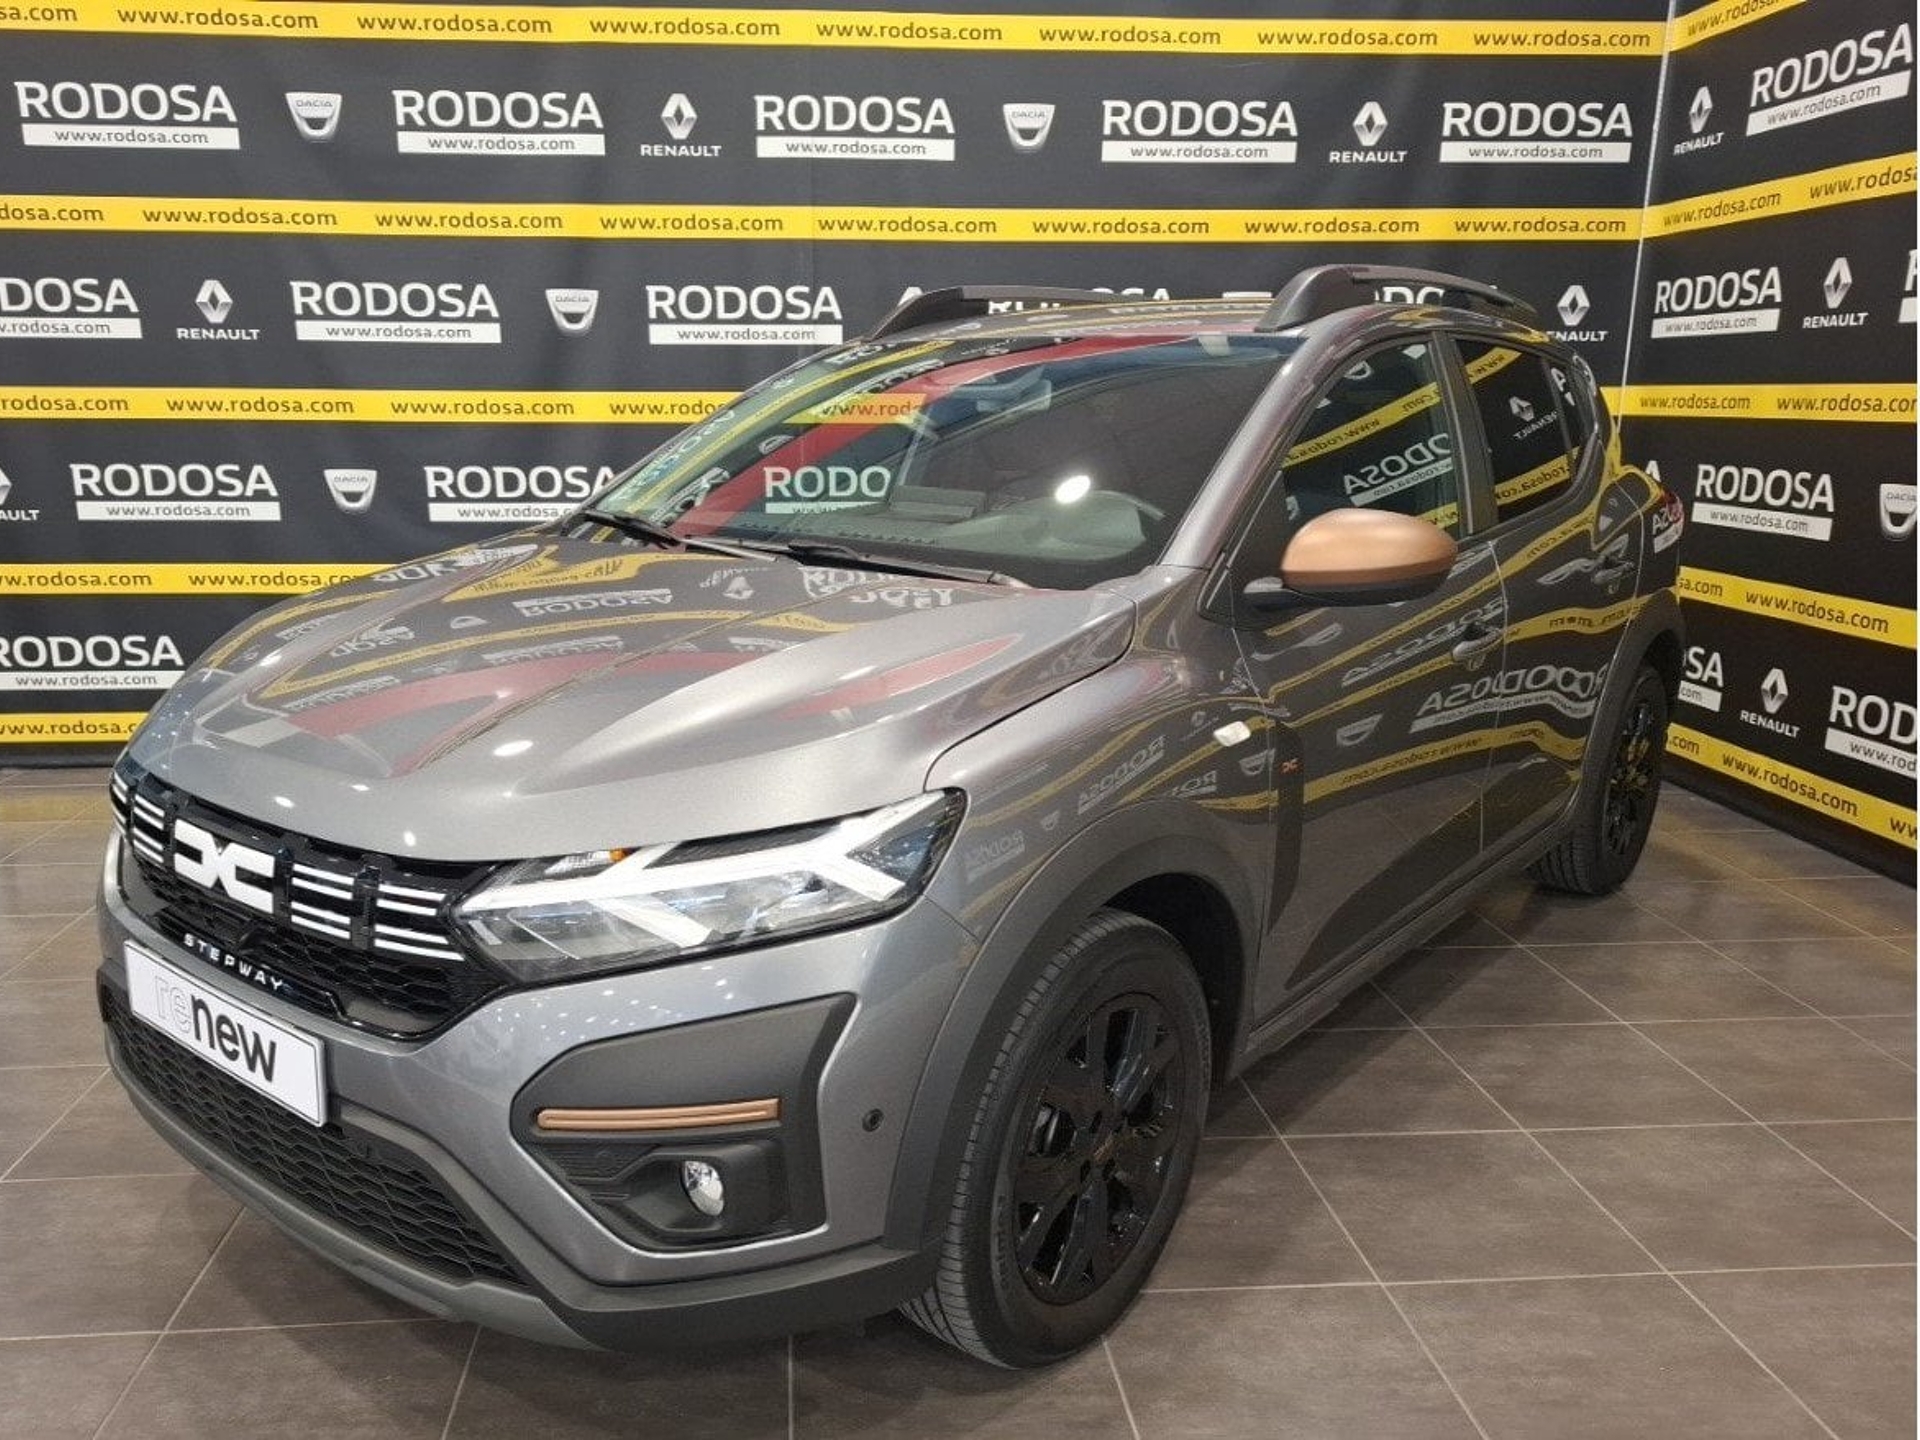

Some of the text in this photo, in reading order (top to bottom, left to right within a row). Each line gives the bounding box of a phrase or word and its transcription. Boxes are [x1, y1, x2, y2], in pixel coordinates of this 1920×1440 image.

[118, 8, 318, 29] www.rodosa.com
[357, 14, 552, 33] www.rodosa.com
[590, 17, 780, 37] www.rodosa.com
[817, 22, 1002, 40] www.rodosa.com
[1040, 26, 1221, 45] www.rodosa.com
[1258, 28, 1437, 46] www.rodosa.com
[1473, 29, 1650, 48] www.rodosa.com
[1749, 23, 1914, 108] RODOSA
[14, 81, 238, 122] RODOSA
[392, 89, 603, 129] RODOSA
[1767, 83, 1881, 126] www.rodosa.com
[754, 95, 956, 134] RODOSA
[1012, 110, 1046, 119] DACIA
[1102, 99, 1298, 137] RODOSA
[1441, 102, 1633, 138] RODOSA
[55, 129, 208, 144] www.rodosa.com
[428, 135, 575, 151] www.rodosa.com
[786, 140, 926, 156] www.rodosa.com
[640, 144, 722, 158] RENAULT
[1131, 144, 1268, 159] www.rodosa.com
[1329, 151, 1407, 164] RENAULT
[1468, 143, 1603, 159] www.rodosa.com
[143, 208, 337, 226] www.rodosa.com
[376, 211, 563, 230] www.rodosa.com
[601, 213, 783, 232] www.rodosa.com
[818, 215, 997, 234] www.rodosa.com
[1033, 217, 1210, 235] www.rodosa.com
[1245, 217, 1420, 235] www.rodosa.com
[1455, 216, 1626, 234] www.rodosa.com
[1663, 191, 1781, 228] www.rodosa.com
[290, 280, 500, 318] RODOSA
[1654, 266, 1783, 314] RODOSA
[645, 284, 843, 321] RODOSA
[326, 323, 472, 340] www.rodosa.com
[1665, 315, 1757, 334] www.rodosa.com
[1802, 312, 1868, 330] RENAULT
[177, 327, 260, 341] RENAULT
[677, 326, 816, 341] www.rodosa.com
[167, 395, 354, 414] www.rodosa.com
[391, 398, 575, 416] www.rodosa.com
[1641, 394, 1750, 410] www.rodosa.com
[69, 463, 278, 498] RODOSA
[1696, 464, 1835, 513] RODOSA
[106, 503, 251, 518] www.rodosa.com
[1710, 510, 1808, 534] www.rodosa.com
[0, 571, 152, 586] w.rodosa.com
[1746, 590, 1889, 634] www.rodosa.com
[15, 674, 158, 687] www.rodosa.com
[0, 720, 138, 735] ww.rodosa.c
[1740, 709, 1800, 739] RENAULT
[1723, 752, 1859, 818] www.rodosa.com
[184, 933, 284, 990] STEPWAY
